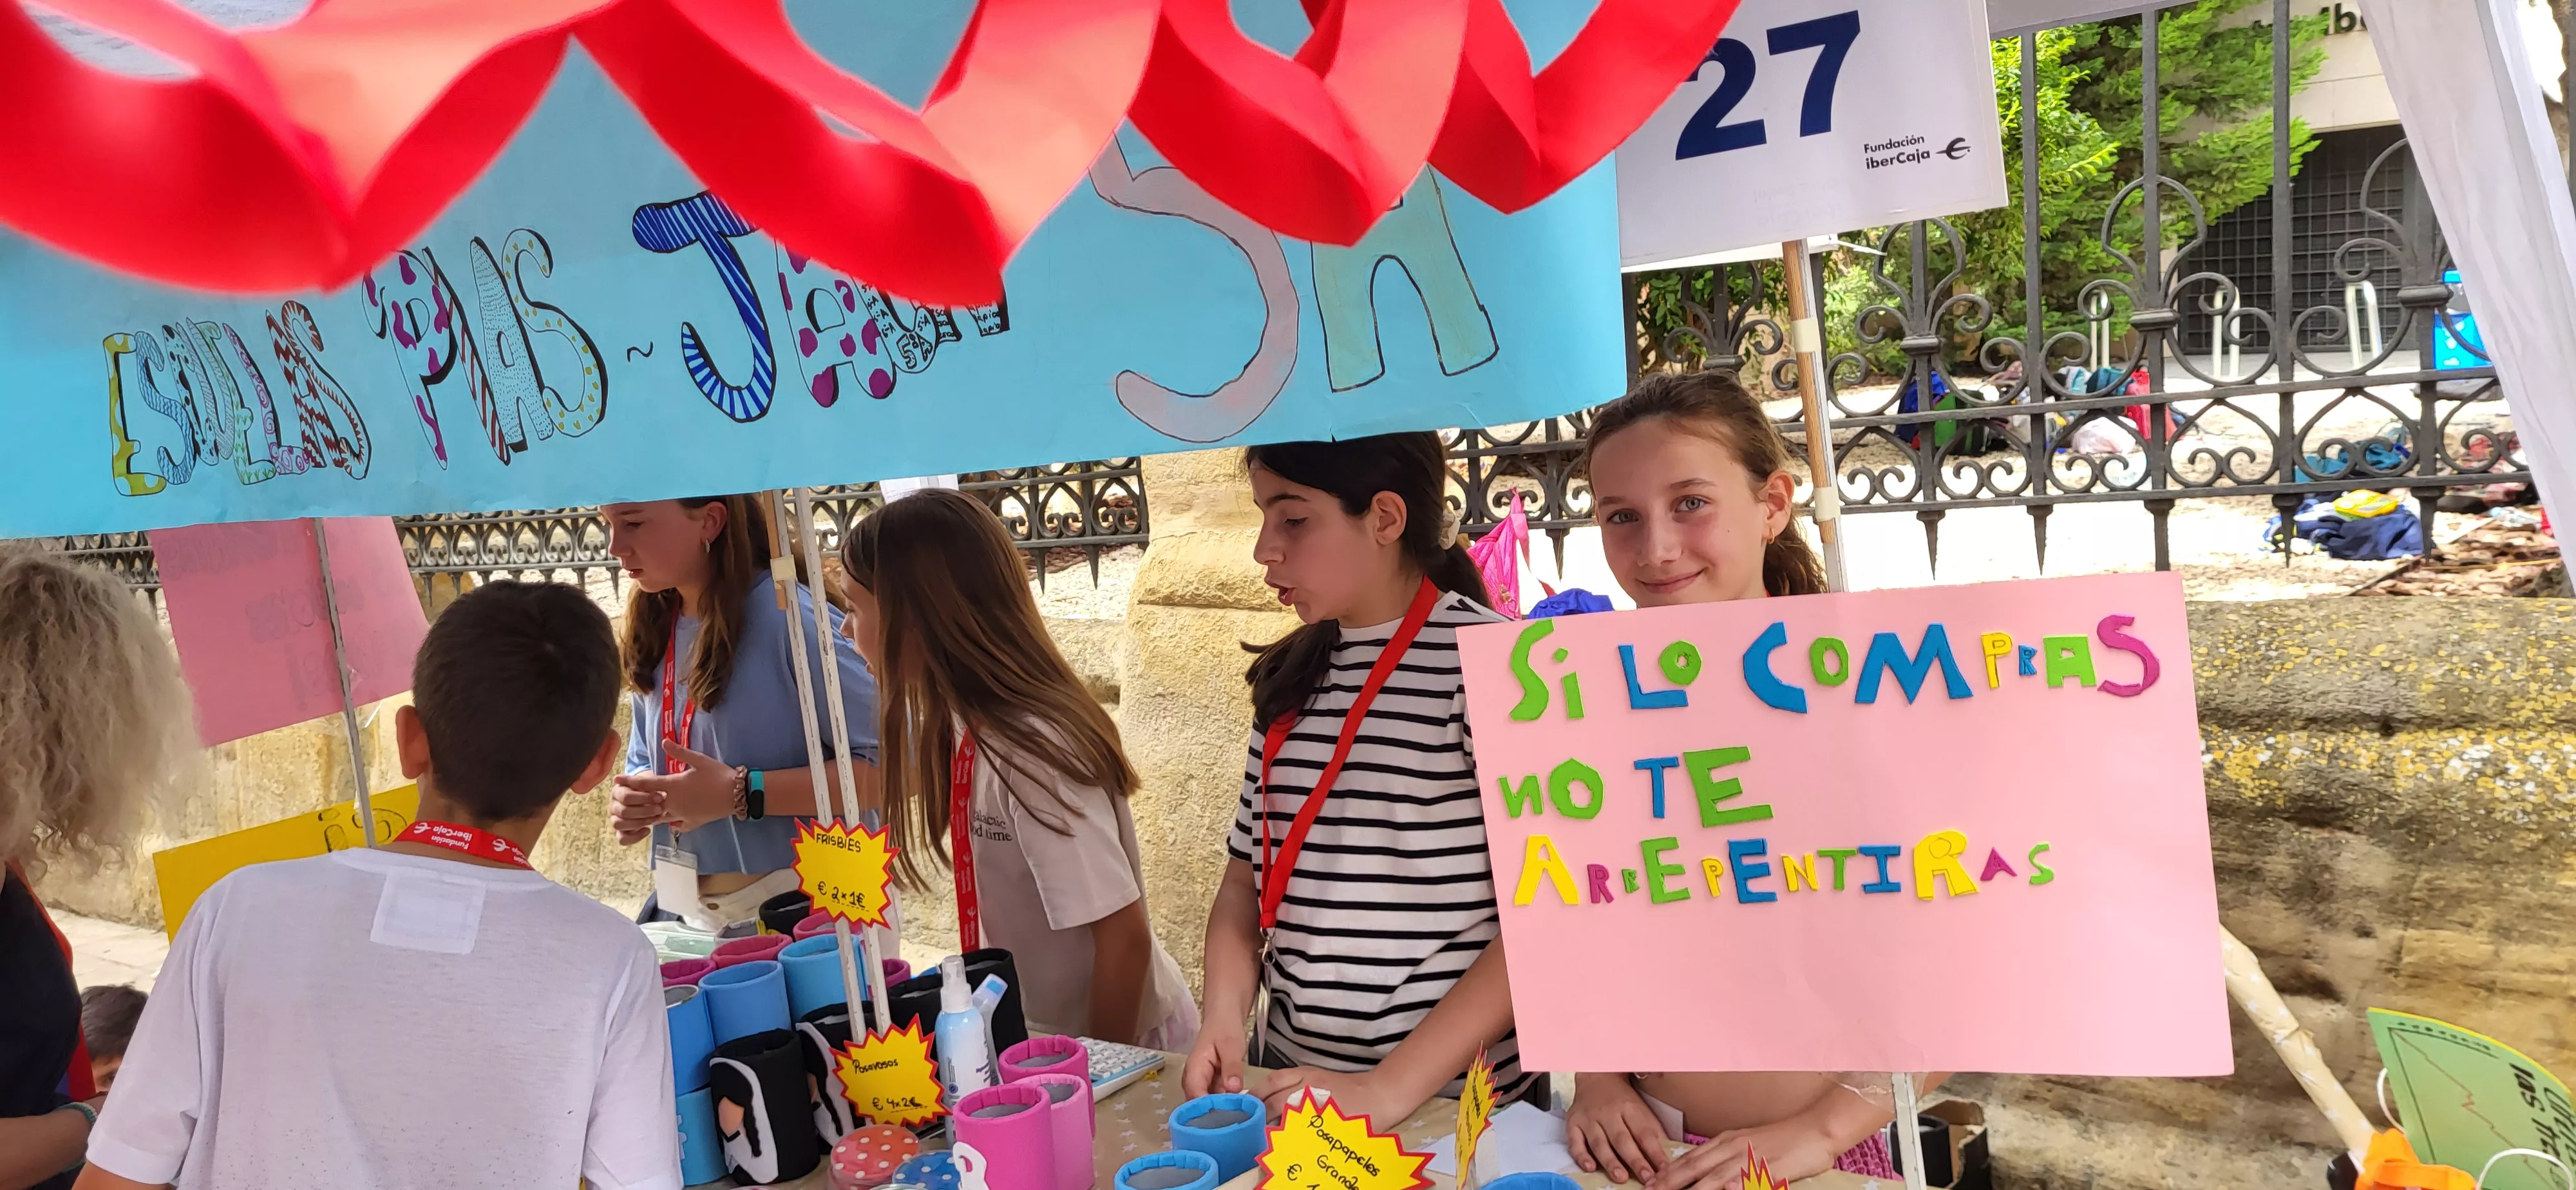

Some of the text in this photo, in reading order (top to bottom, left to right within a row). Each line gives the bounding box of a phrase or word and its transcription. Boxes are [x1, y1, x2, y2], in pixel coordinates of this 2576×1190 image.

[1676, 10, 1861, 161] 27
[1864, 134, 1925, 153] Fundación
[1865, 148, 1931, 169] iberCaja
[362, 228, 609, 471] PIAS
[1509, 614, 2161, 721] Si LO COMPRAS
[1633, 746, 1774, 828] TE
[816, 833, 862, 853] FRISBIES
[1513, 829, 2055, 906] ARREPENTIRAS
[1307, 1115, 1381, 1177] Posapapeles
